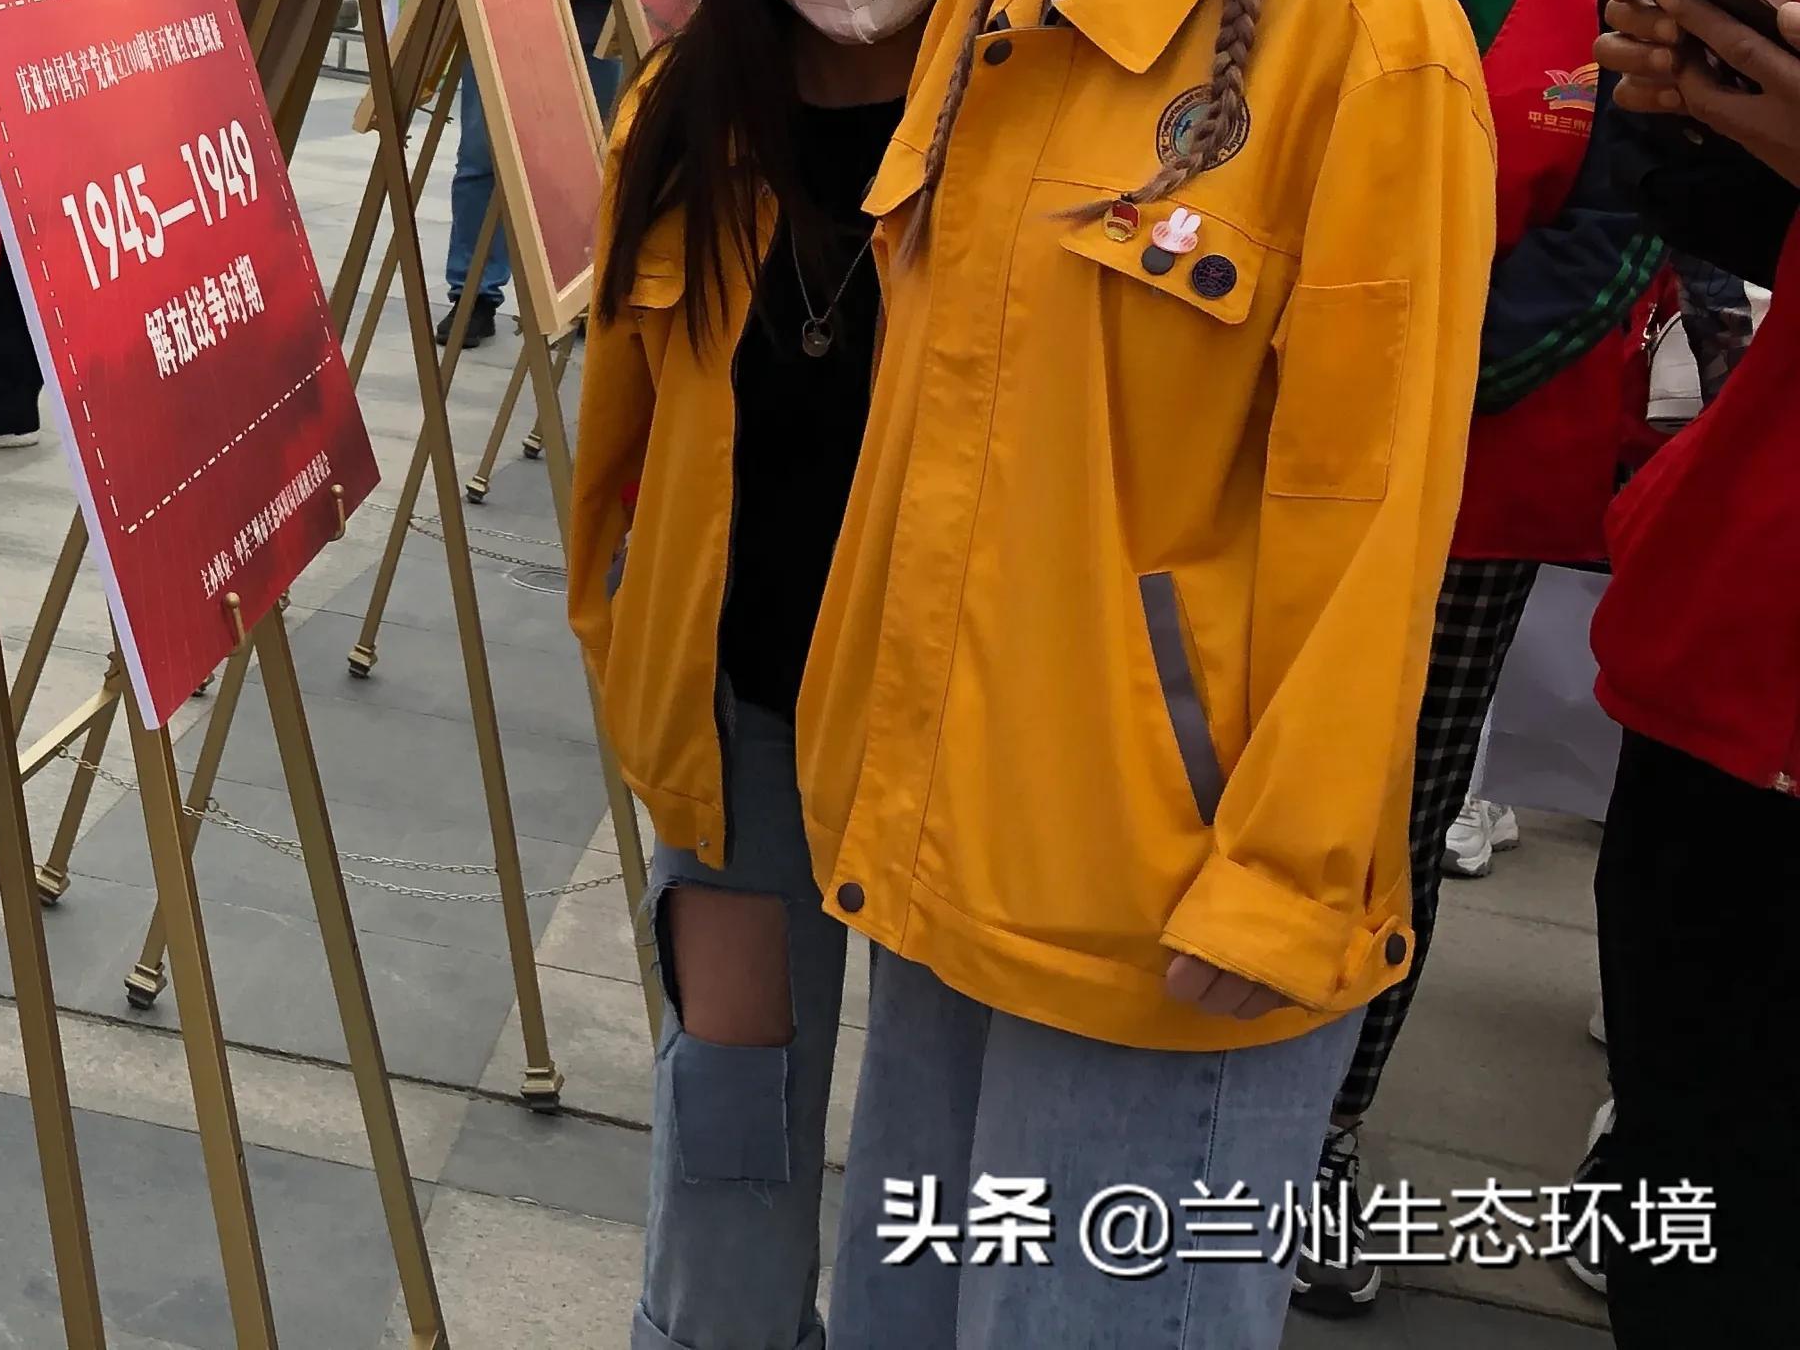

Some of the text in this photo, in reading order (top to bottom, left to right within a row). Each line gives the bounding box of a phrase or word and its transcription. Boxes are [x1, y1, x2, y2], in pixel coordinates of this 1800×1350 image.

[144, 254, 265, 380] 解放战争时期
